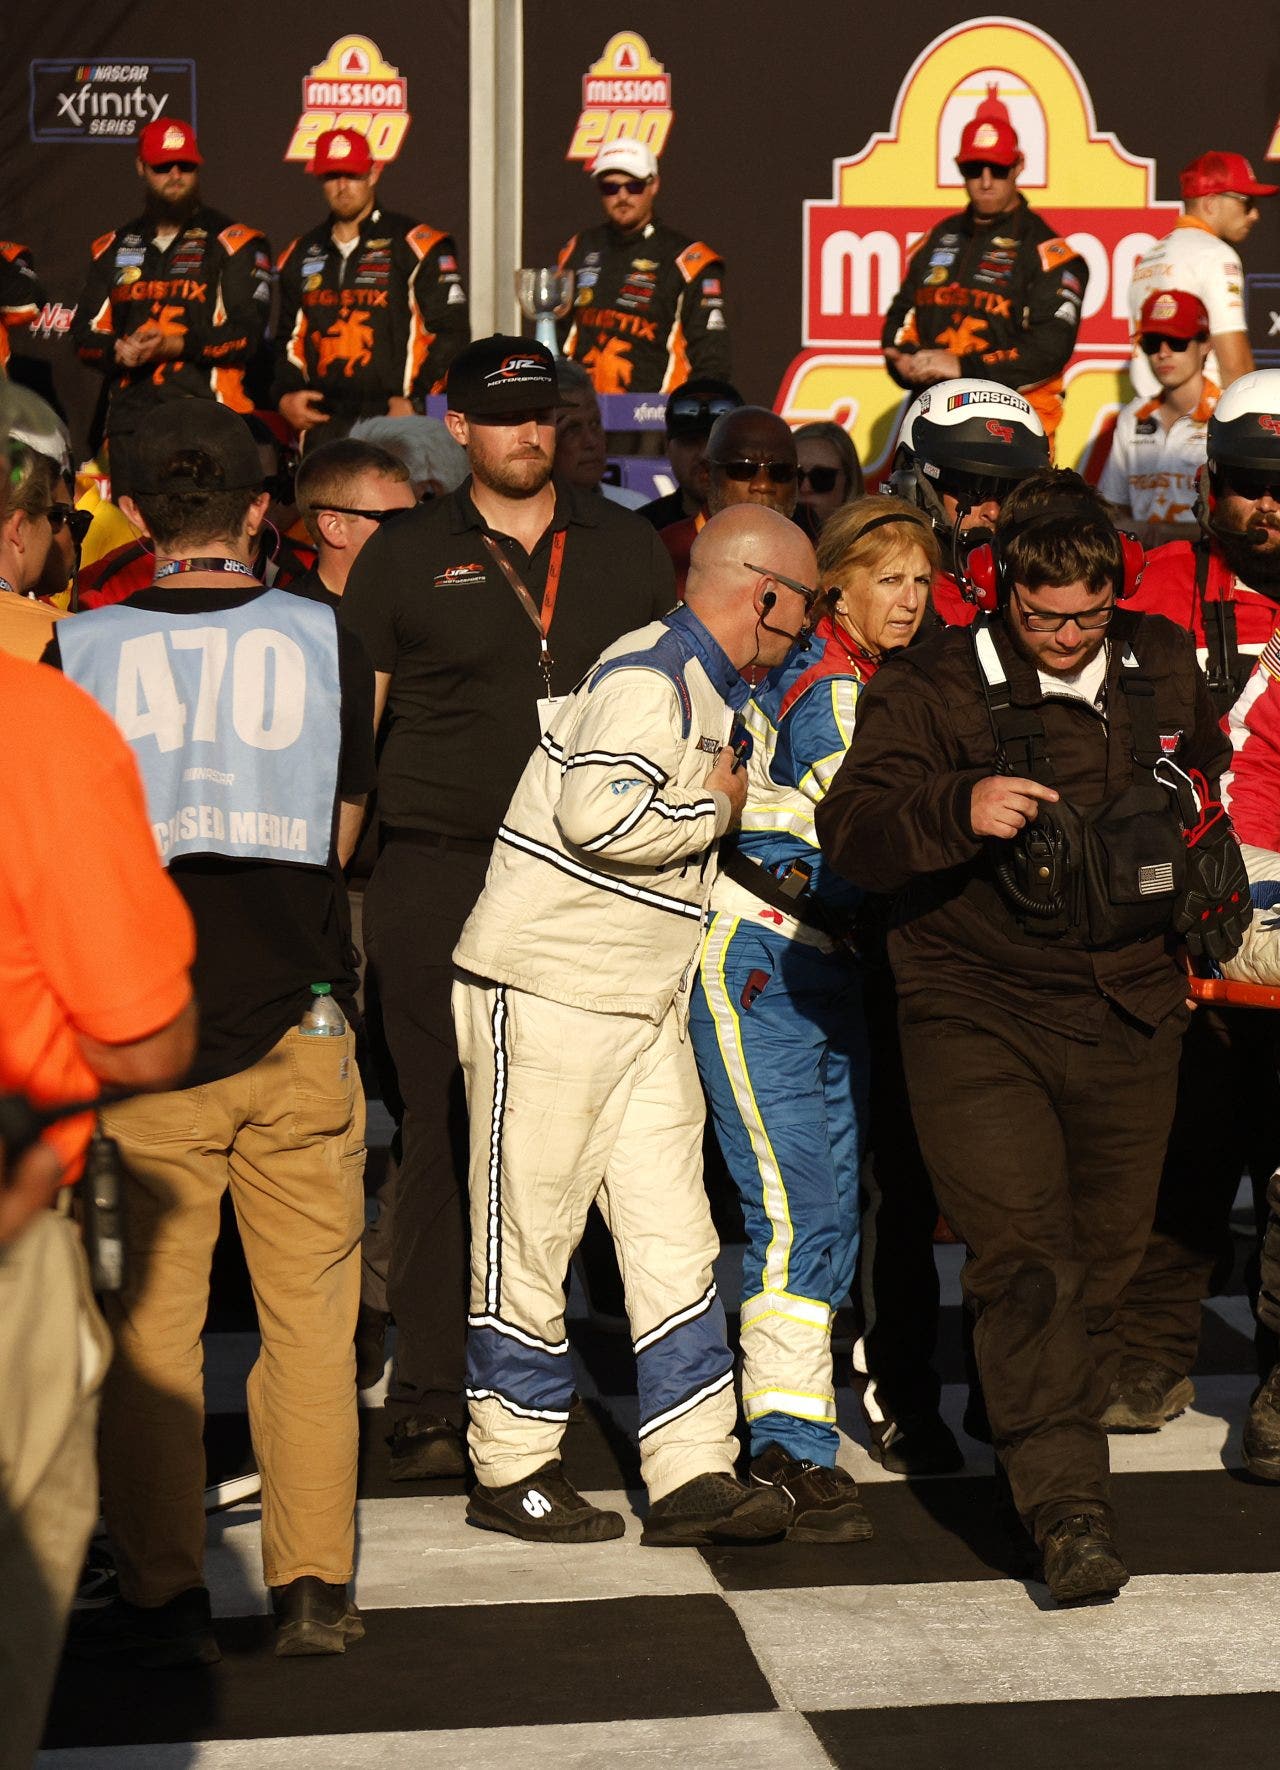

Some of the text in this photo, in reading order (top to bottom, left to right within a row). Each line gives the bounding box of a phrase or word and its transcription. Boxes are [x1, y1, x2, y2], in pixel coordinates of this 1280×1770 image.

[93, 65, 149, 82] NASCAR
[56, 83, 169, 126] xfinity
[89, 119, 136, 135] SERIES
[968, 391, 1029, 413] NASCAR
[115, 626, 306, 753] 470
[191, 768, 235, 785] NASCAR
[229, 811, 308, 851] MEDIA
